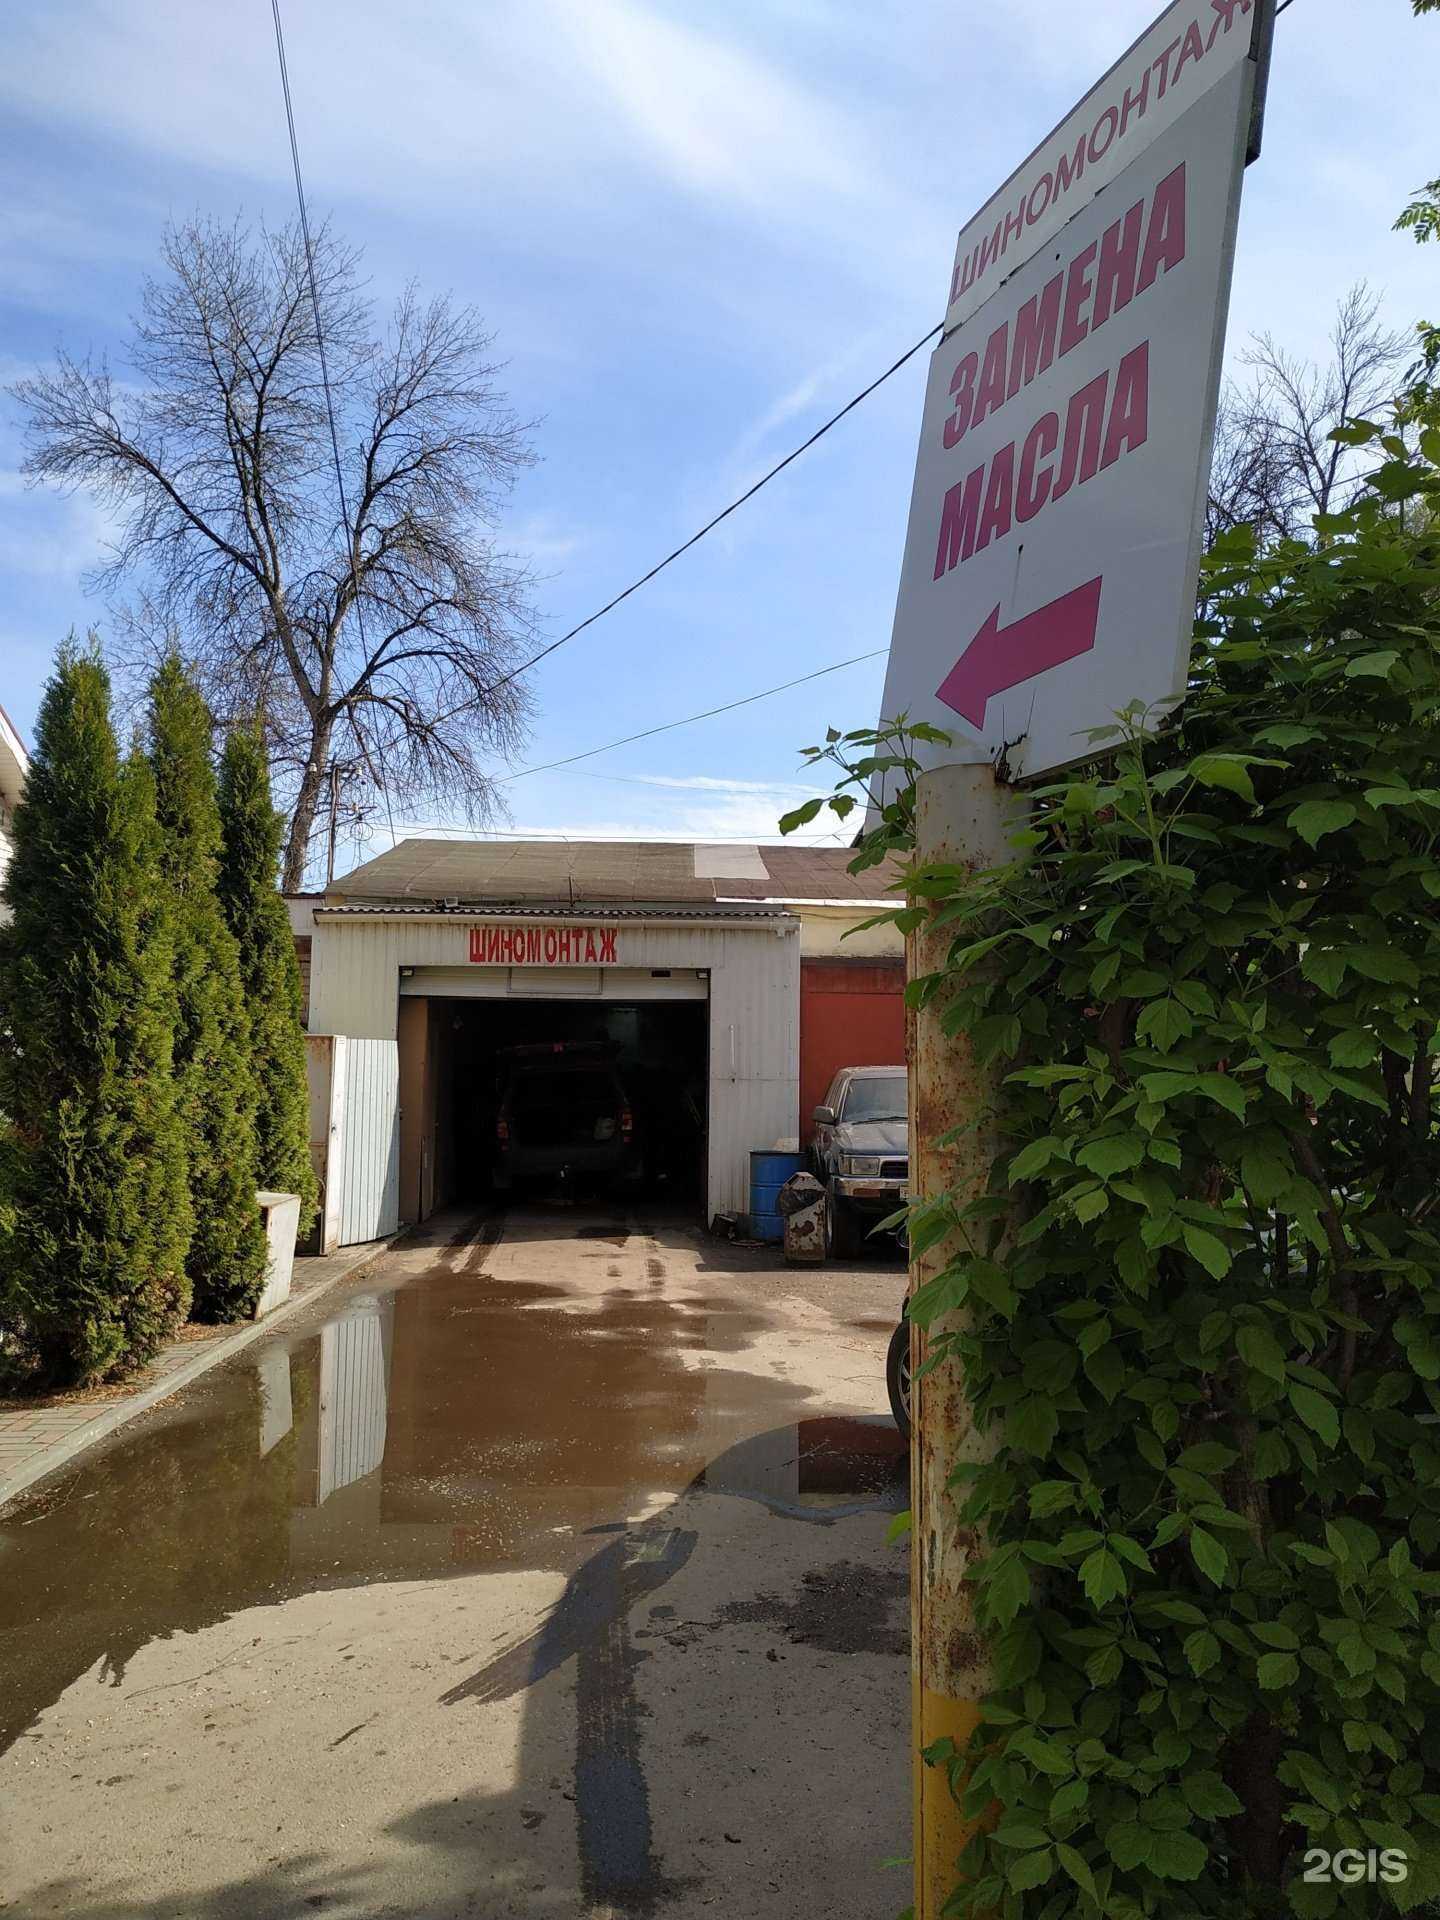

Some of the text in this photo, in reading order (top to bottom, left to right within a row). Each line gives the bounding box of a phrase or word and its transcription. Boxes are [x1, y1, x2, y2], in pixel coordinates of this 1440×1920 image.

[942, 161, 1187, 451] ЗАМЕНА
[932, 340, 1150, 582] МАСЛА
[469, 927, 618, 963] ШИНОМОНТАЖ
